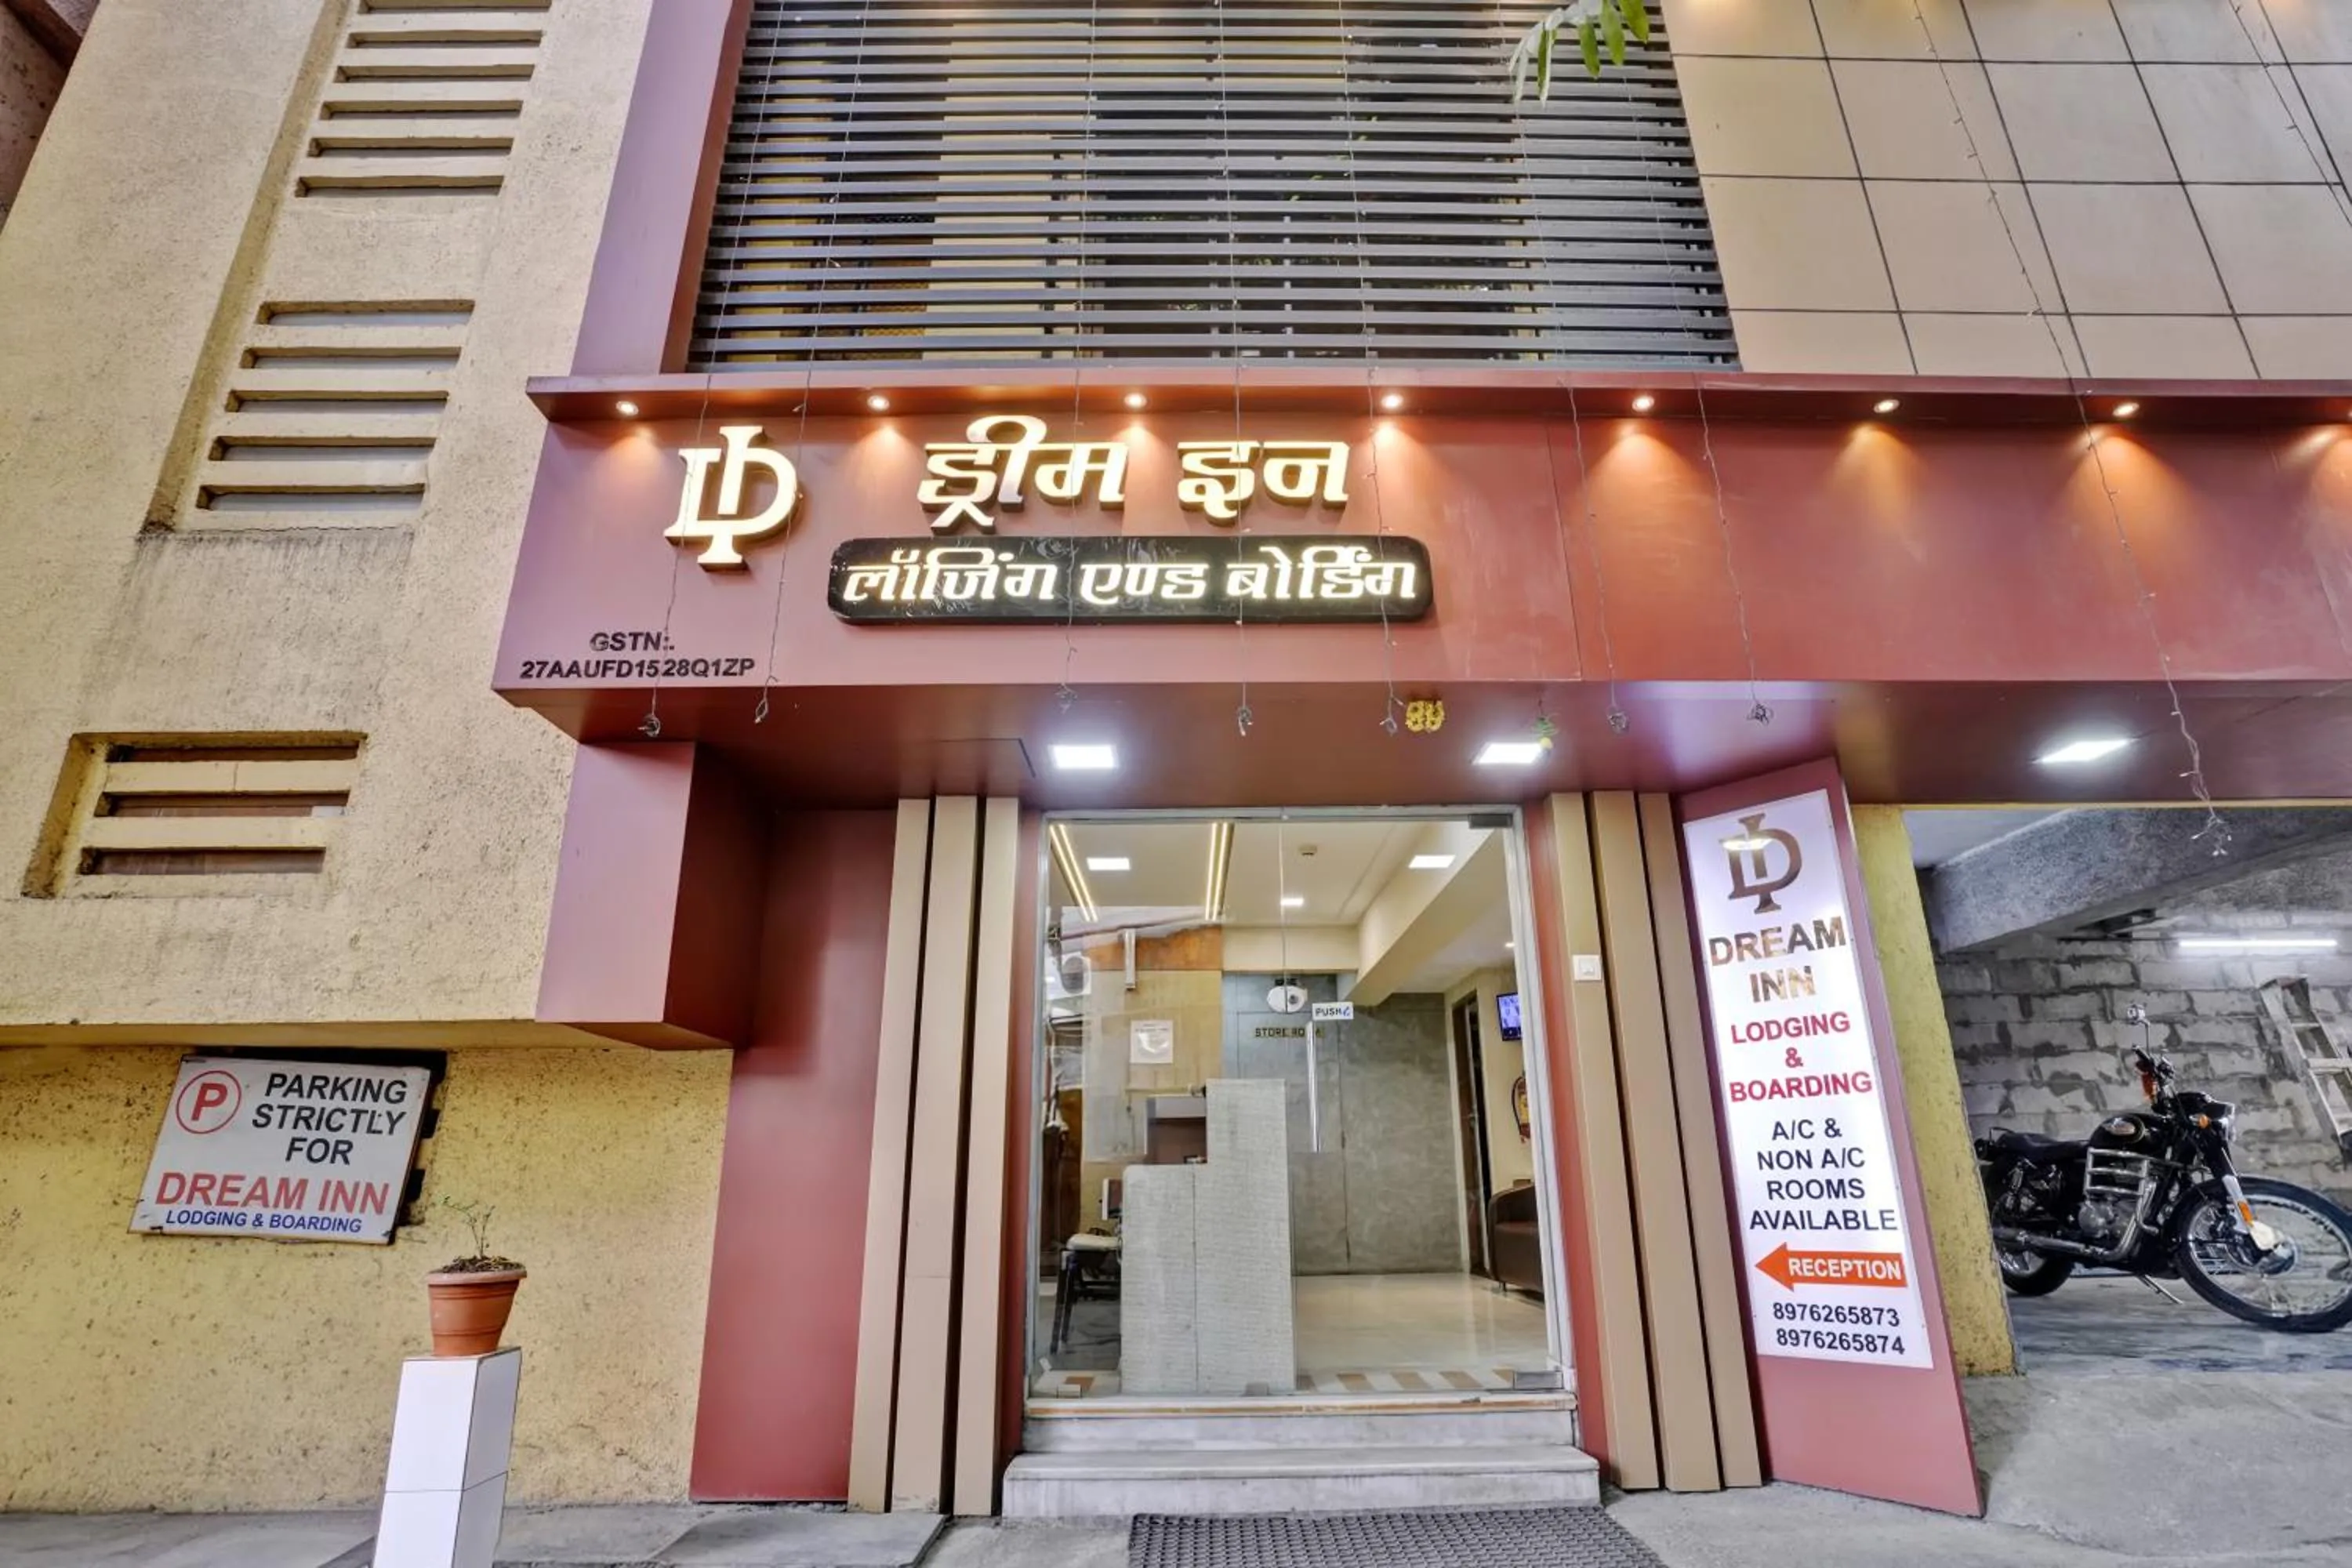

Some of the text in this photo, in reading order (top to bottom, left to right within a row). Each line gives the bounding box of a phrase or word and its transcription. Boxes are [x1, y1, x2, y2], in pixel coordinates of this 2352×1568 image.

[917, 415, 1350, 534] ड्रीम इन
[520, 658, 755, 679] 27AAUFD1528Q1ZP
[1708, 915, 1846, 967] DREAM
[1749, 965, 1817, 1004] INN
[1315, 1007, 1341, 1017] PUSH
[1255, 1027, 1325, 1038] STORE ROM
[1730, 1011, 1851, 1044] LODGING
[1784, 1047, 1803, 1069] &
[264, 1073, 408, 1105] PARKING
[1729, 1071, 1873, 1103] BOARDING
[191, 1082, 228, 1121] P
[252, 1103, 406, 1135] STRICTLY
[1771, 1117, 1842, 1141] A/C &
[285, 1137, 354, 1165] FOR
[1757, 1147, 1865, 1171] NON A/C
[154, 1172, 390, 1215] DREAM INN
[1766, 1178, 1865, 1200] ROOMS
[165, 1210, 363, 1233] LODGING & BOARDING
[1749, 1209, 1898, 1230] AVAILABLE
[1788, 1258, 1902, 1280] RECEPTION
[1773, 1302, 1900, 1327] 8976265873
[1776, 1328, 1906, 1356] 8976265874
